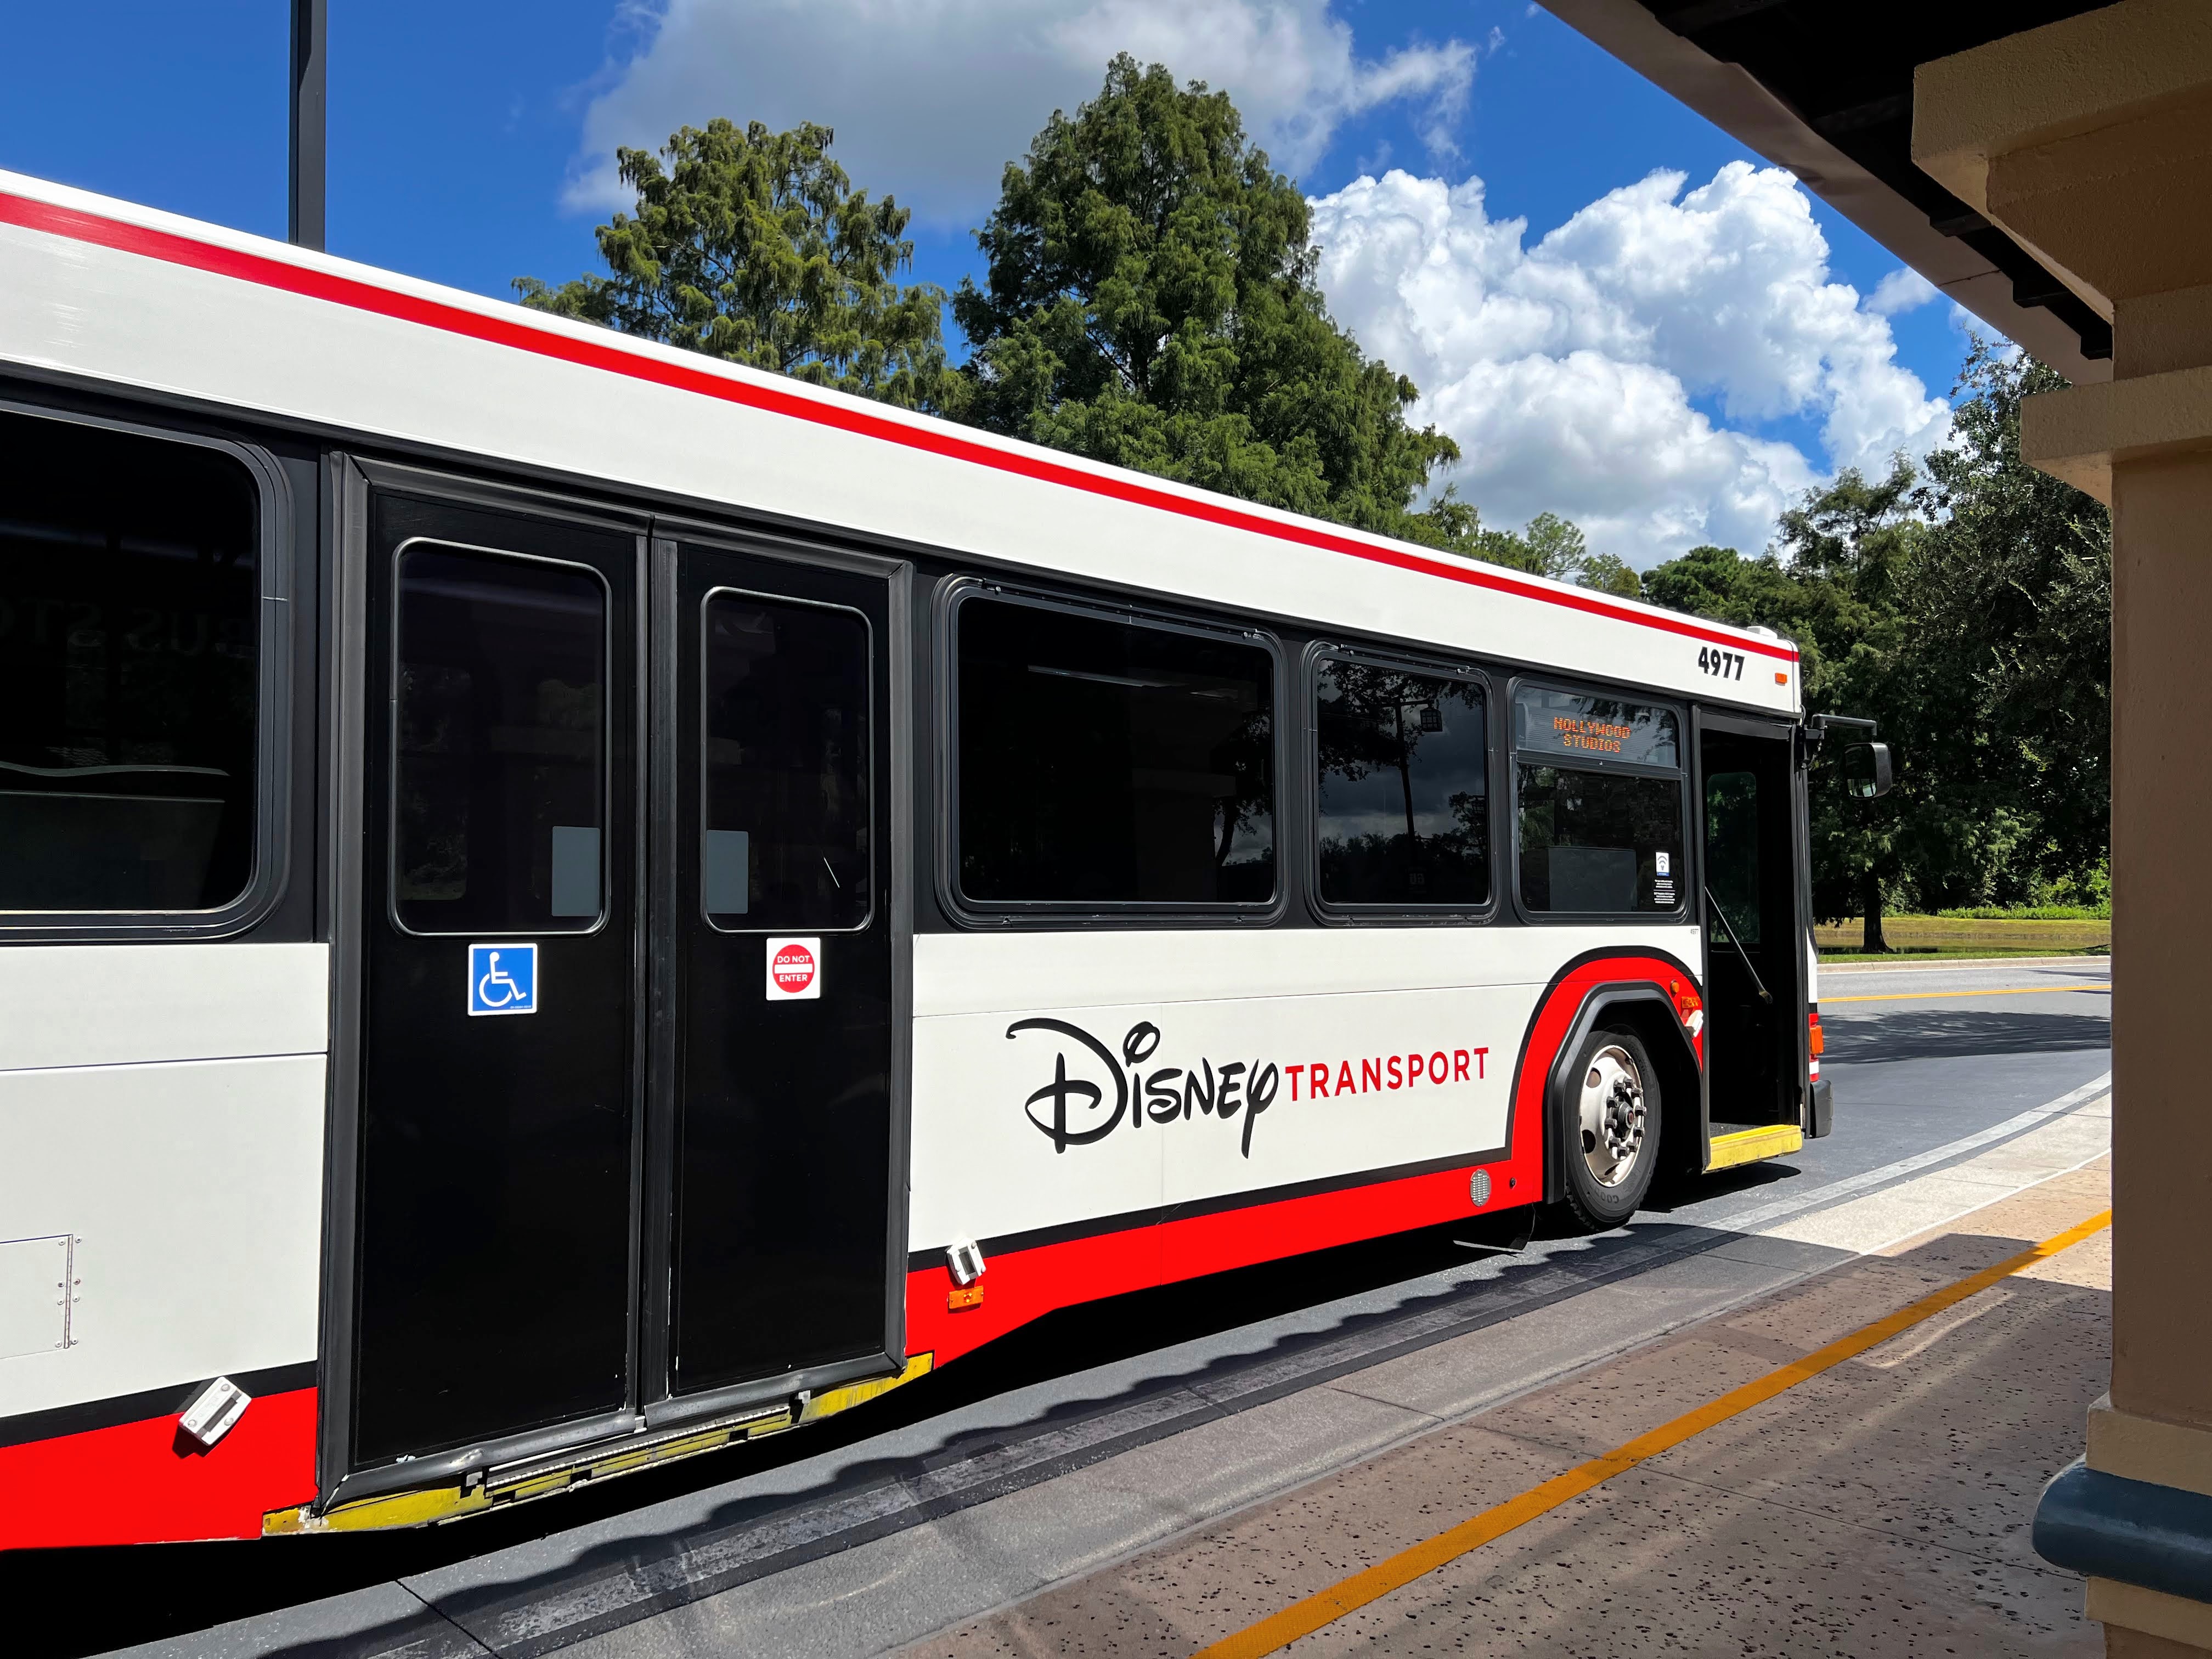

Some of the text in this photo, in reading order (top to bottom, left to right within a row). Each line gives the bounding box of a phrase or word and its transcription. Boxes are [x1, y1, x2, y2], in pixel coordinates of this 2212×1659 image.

[1698, 646, 1745, 681] 4977
[1554, 717, 1632, 739] HOLLYWOOD
[1564, 733, 1621, 753] STUDIOS
[779, 974, 808, 982] ENTER
[1285, 1047, 1488, 1101] TRANSPORT
